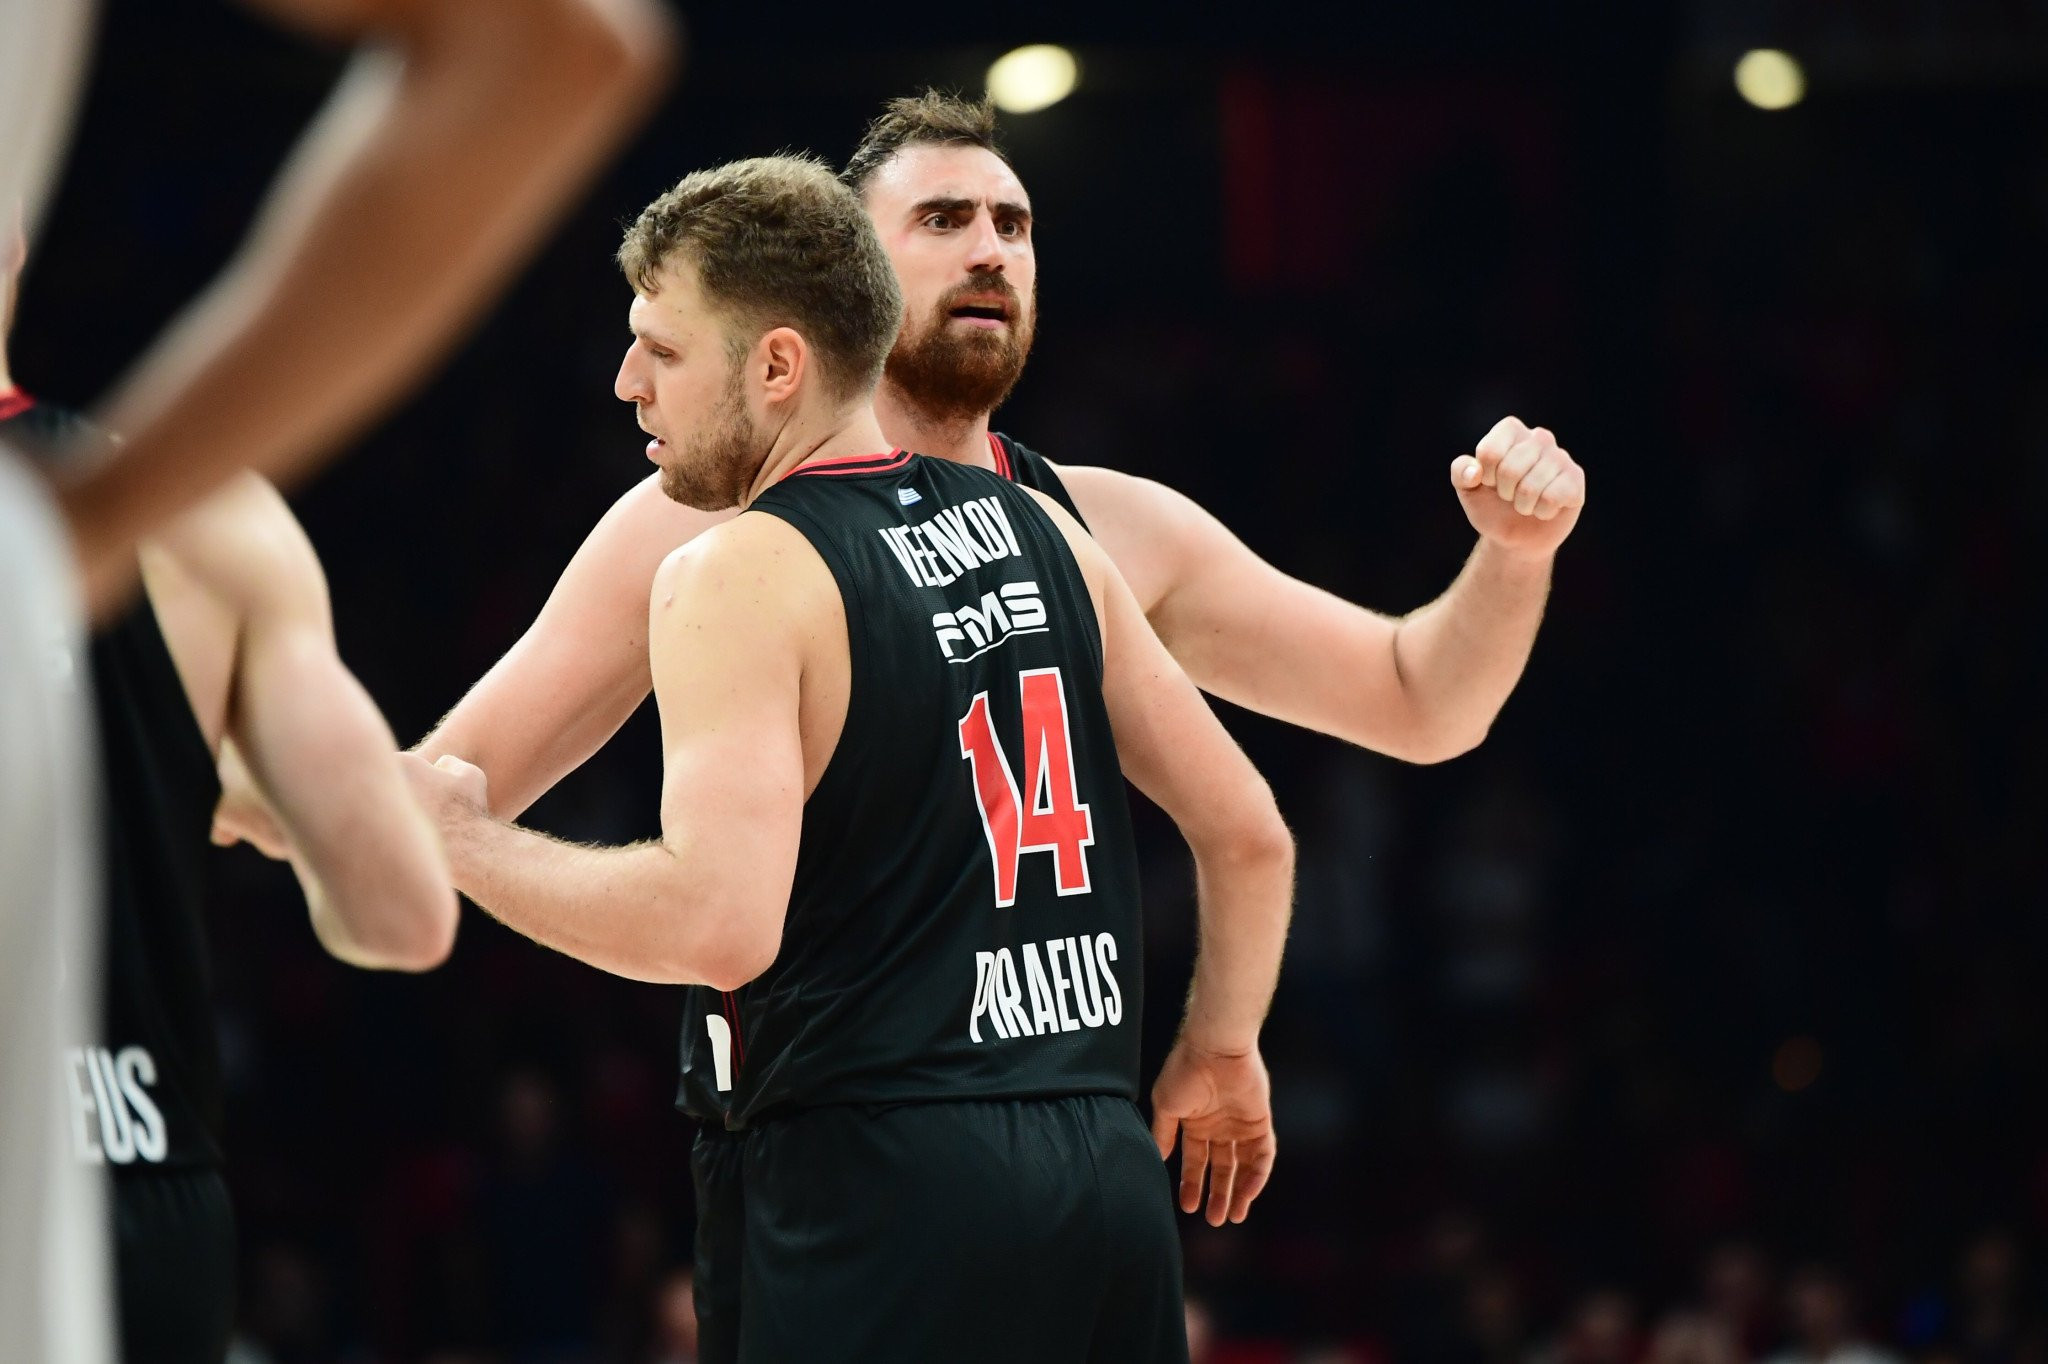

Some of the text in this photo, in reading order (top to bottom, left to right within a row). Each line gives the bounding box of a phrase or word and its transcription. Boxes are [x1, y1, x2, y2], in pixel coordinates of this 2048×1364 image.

[878, 495, 1022, 588] VEENKOV
[958, 666, 1096, 909] 14
[969, 932, 1123, 1044] PIRAEUS
